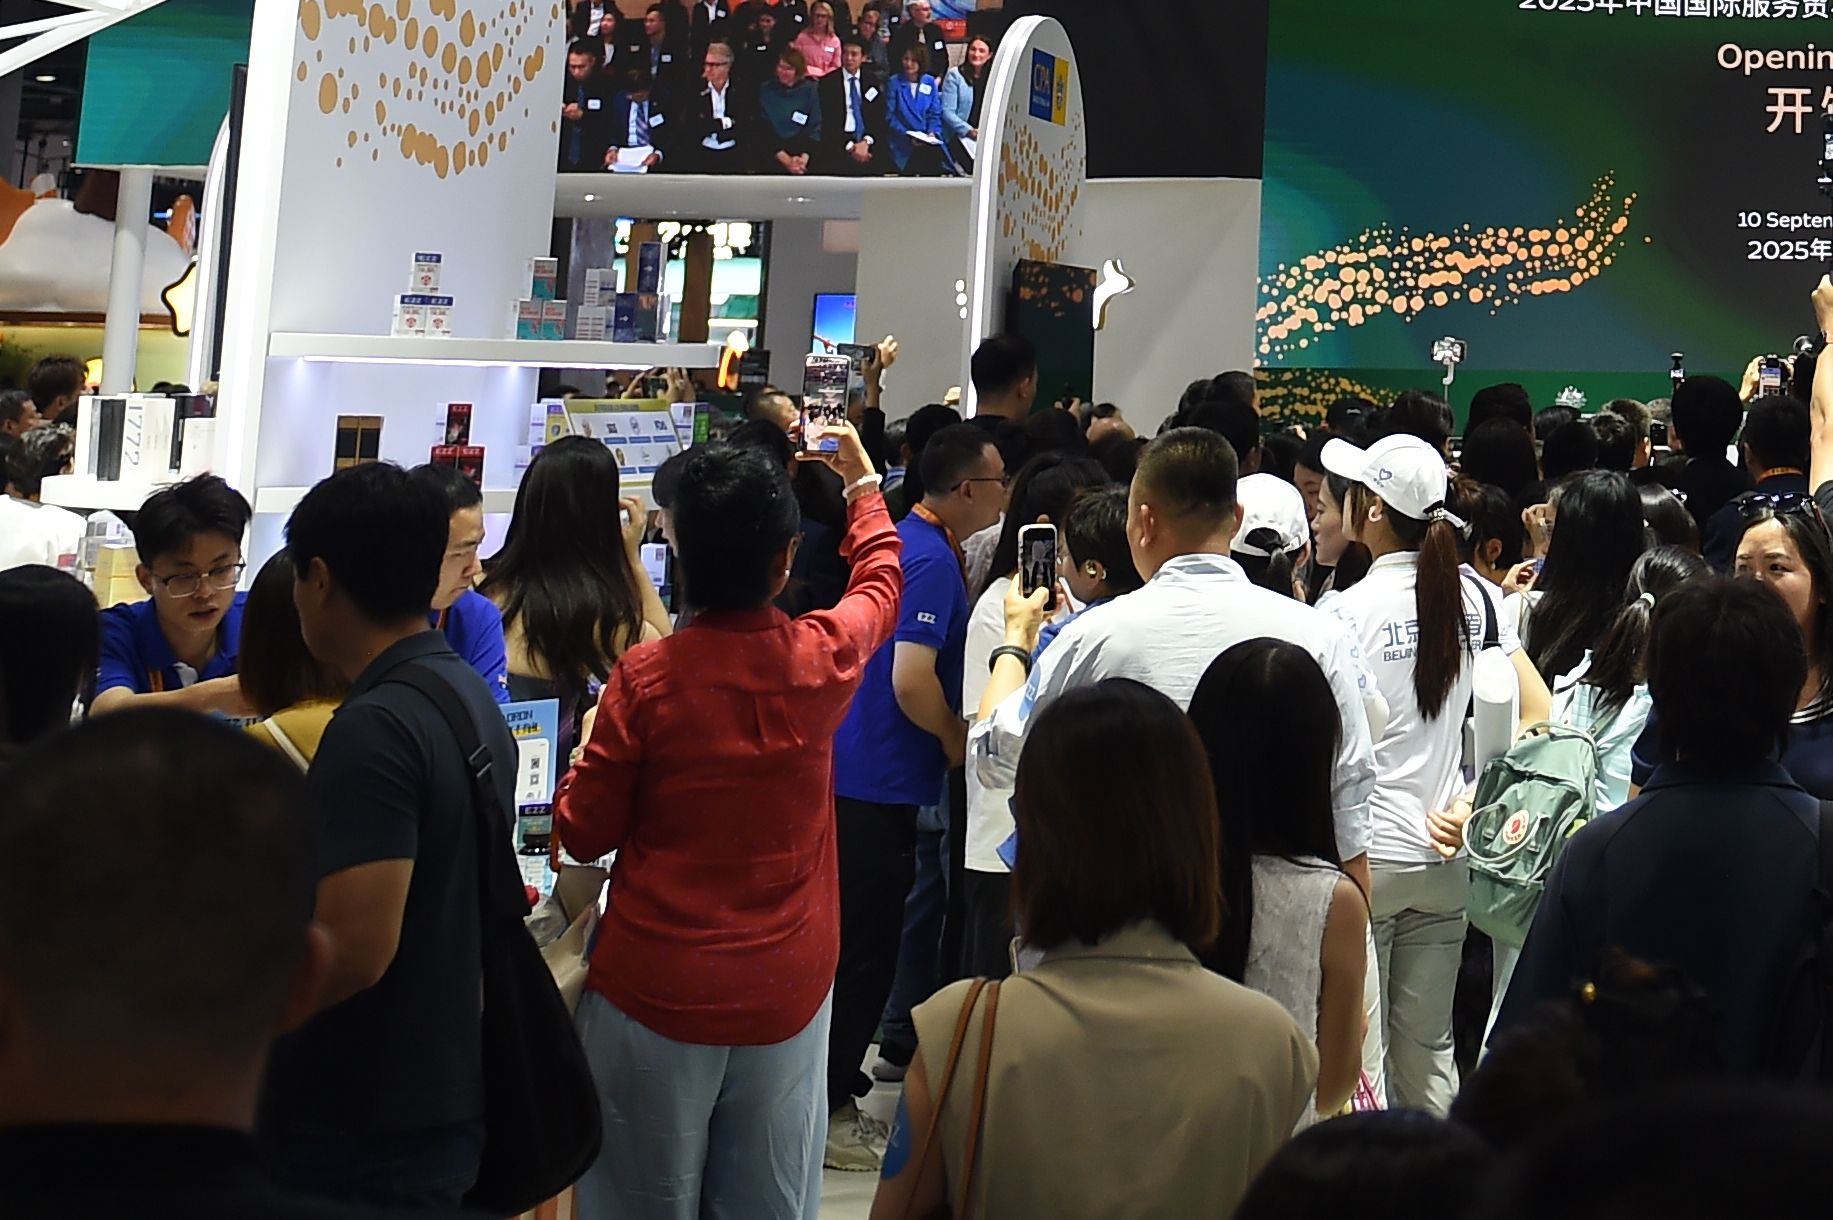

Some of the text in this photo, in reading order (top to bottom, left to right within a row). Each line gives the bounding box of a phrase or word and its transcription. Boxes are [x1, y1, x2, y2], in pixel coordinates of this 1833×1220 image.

[1737, 211, 1762, 228] 10
[917, 611, 937, 625] EZZ
[524, 805, 547, 816] EZZ
